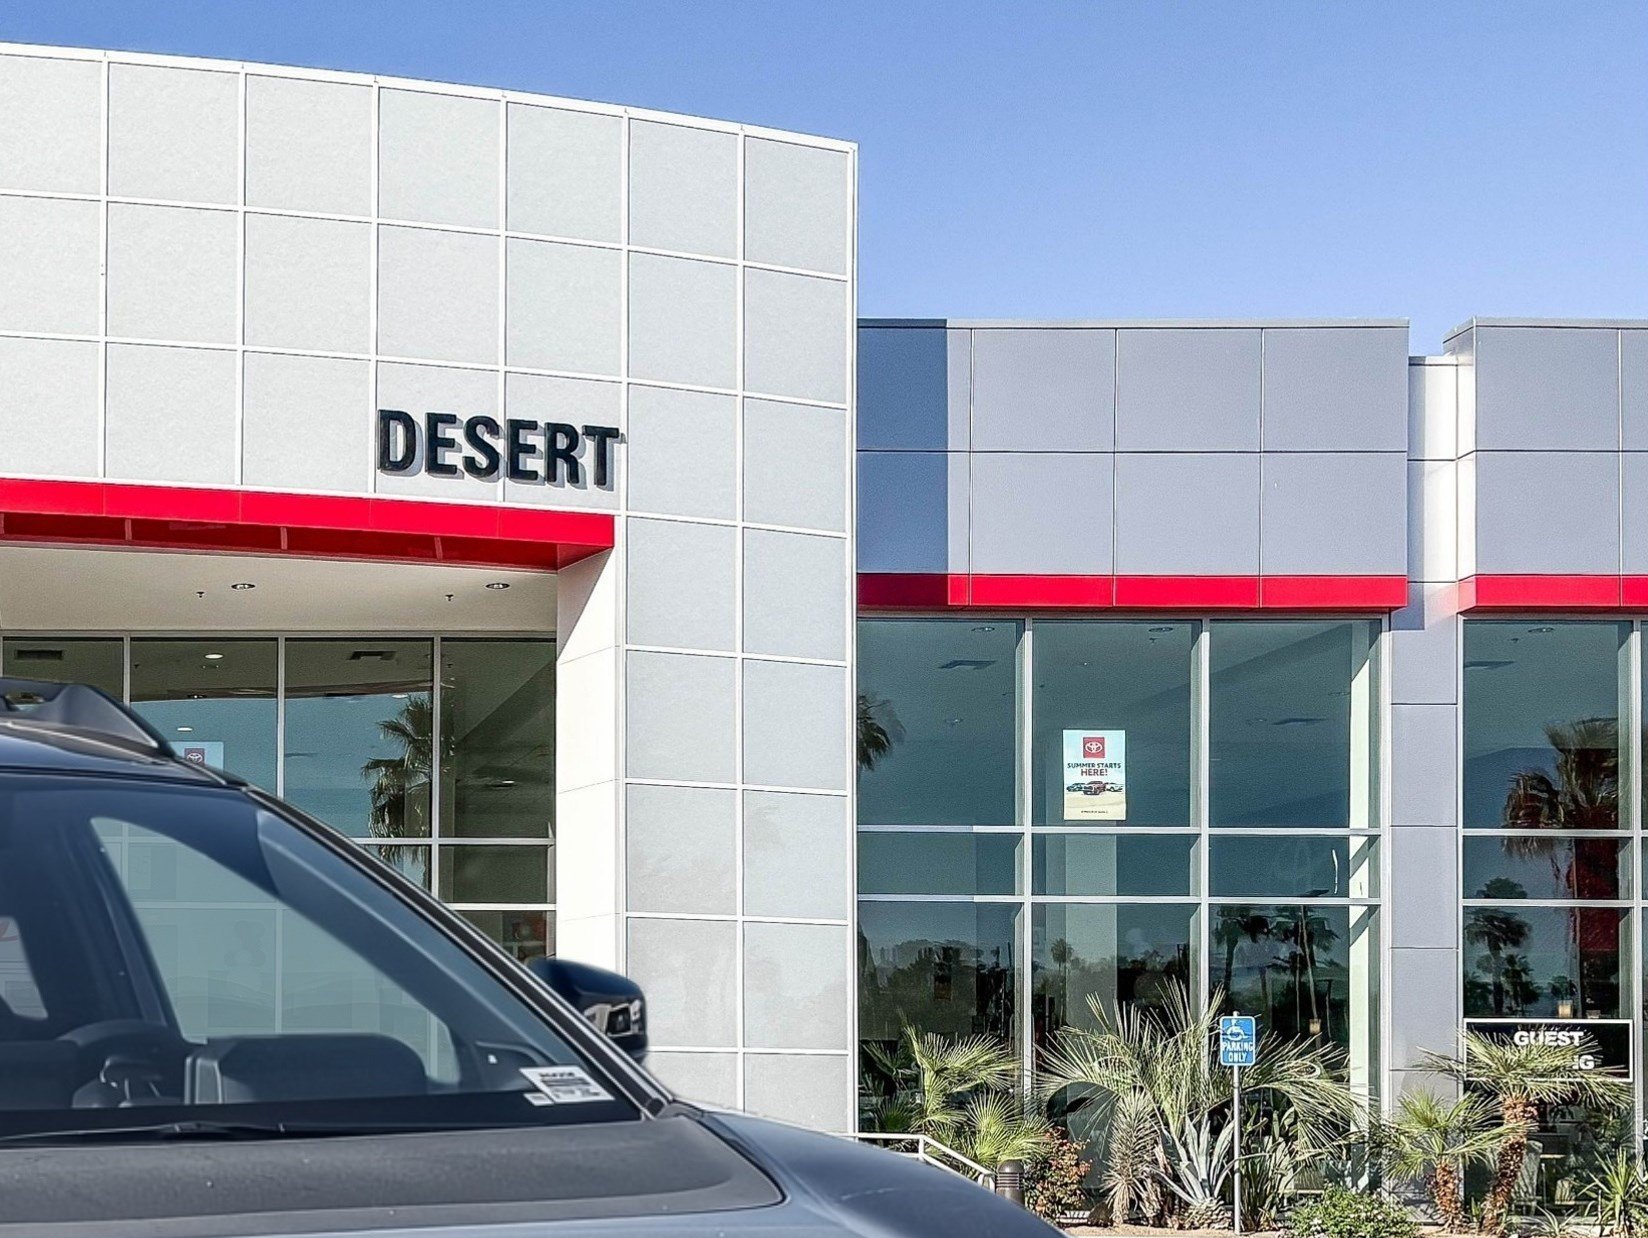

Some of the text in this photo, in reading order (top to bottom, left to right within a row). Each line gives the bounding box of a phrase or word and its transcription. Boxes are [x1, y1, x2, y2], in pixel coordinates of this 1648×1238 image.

[377, 409, 620, 486] DESERT
[1513, 1031, 1585, 1047] GUEST
[1222, 1042, 1254, 1052] PARKING
[1228, 1052, 1248, 1062] ONLY
